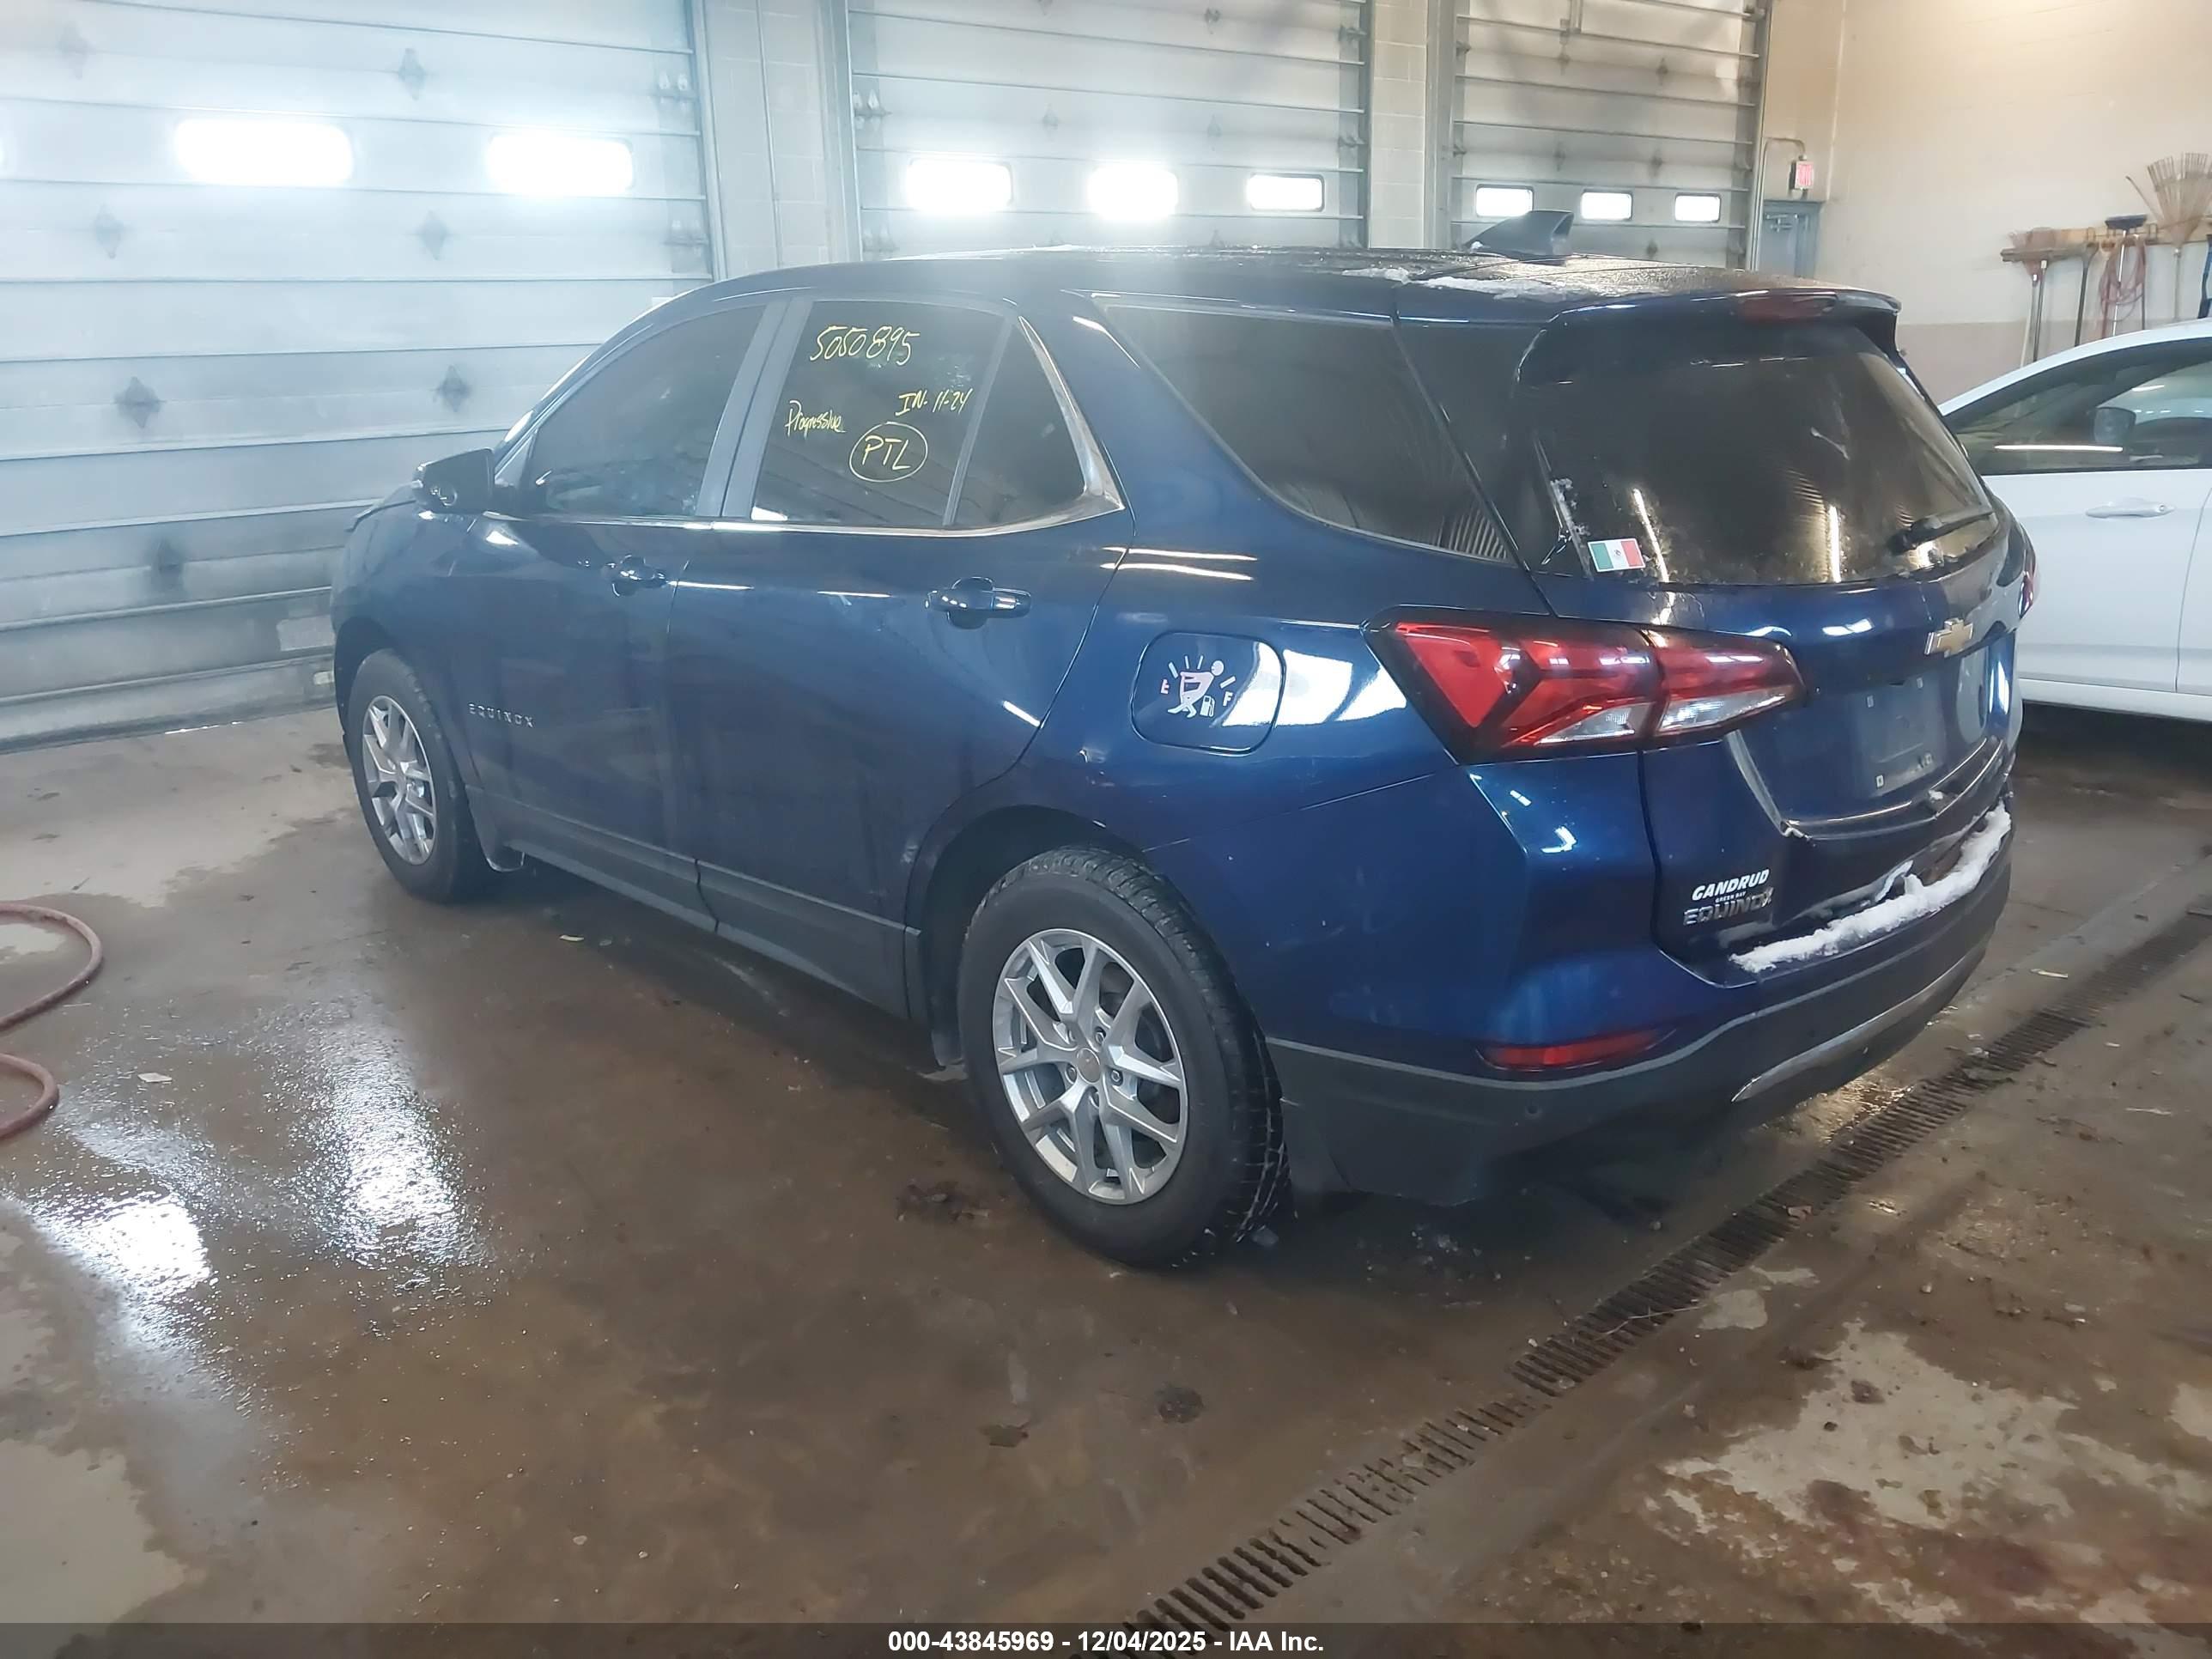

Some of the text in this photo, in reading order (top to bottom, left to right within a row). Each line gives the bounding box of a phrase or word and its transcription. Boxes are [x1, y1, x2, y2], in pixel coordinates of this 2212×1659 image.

[810, 325, 920, 366] 5050895
[862, 434, 910, 471] PTL
[1160, 678, 1170, 694] E
[1223, 691, 1234, 706] F
[468, 702, 533, 728] EQUINOX
[1692, 869, 1770, 901] GANDRUD
[1683, 886, 1774, 926] EQUINOX
